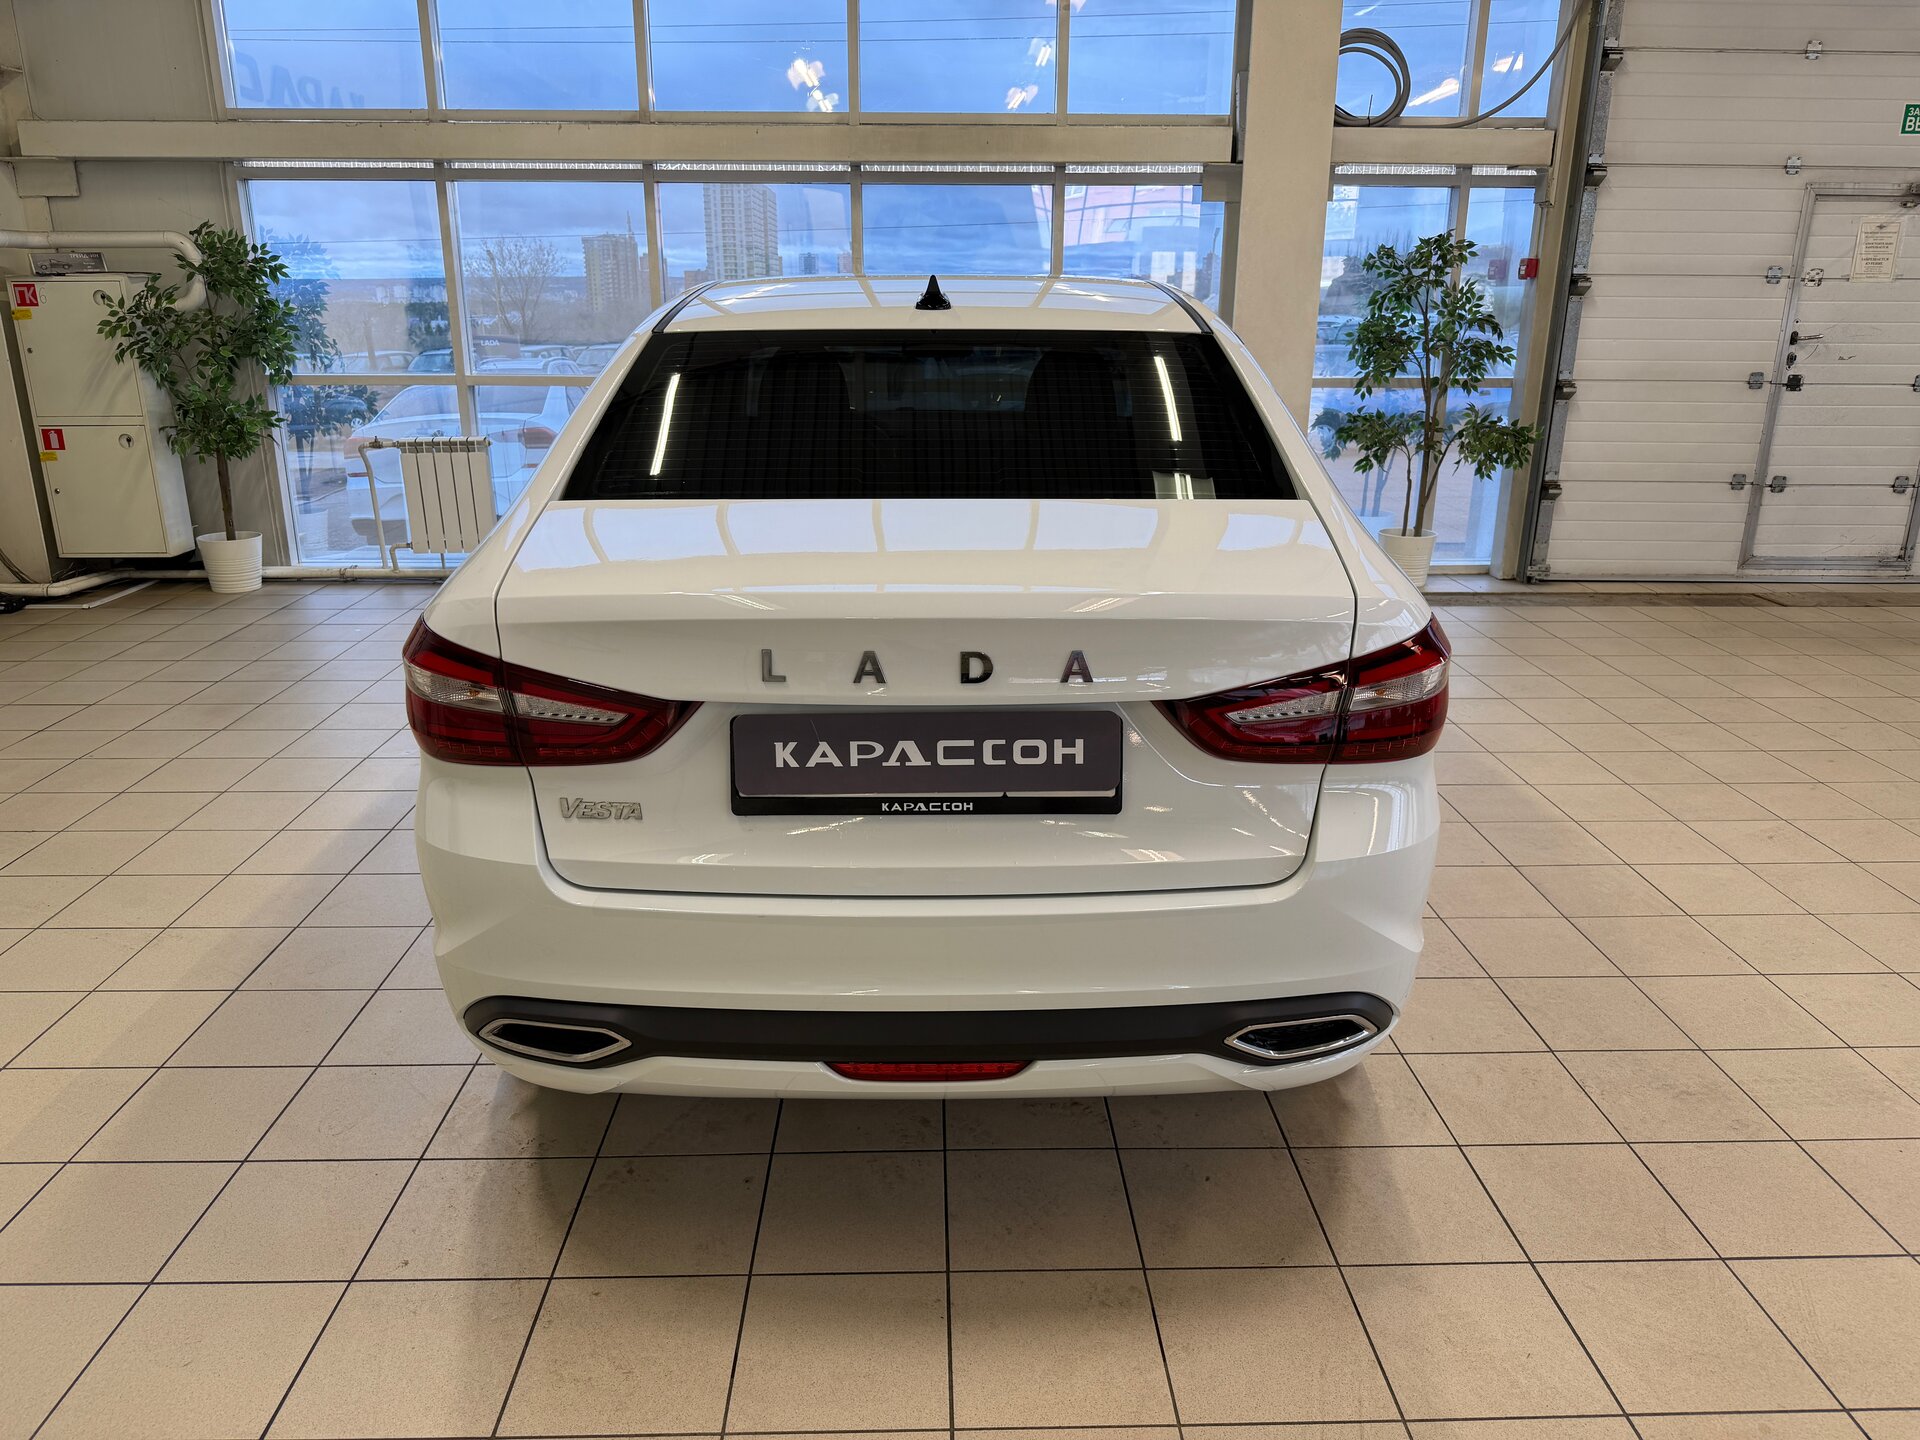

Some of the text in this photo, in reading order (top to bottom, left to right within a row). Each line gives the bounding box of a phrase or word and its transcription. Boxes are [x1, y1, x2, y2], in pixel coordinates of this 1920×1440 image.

[15, 286, 37, 304] ПК
[761, 648, 1094, 684] LADA
[774, 738, 1084, 768] КАРАССОН
[882, 802, 974, 812] КАРАССОН
